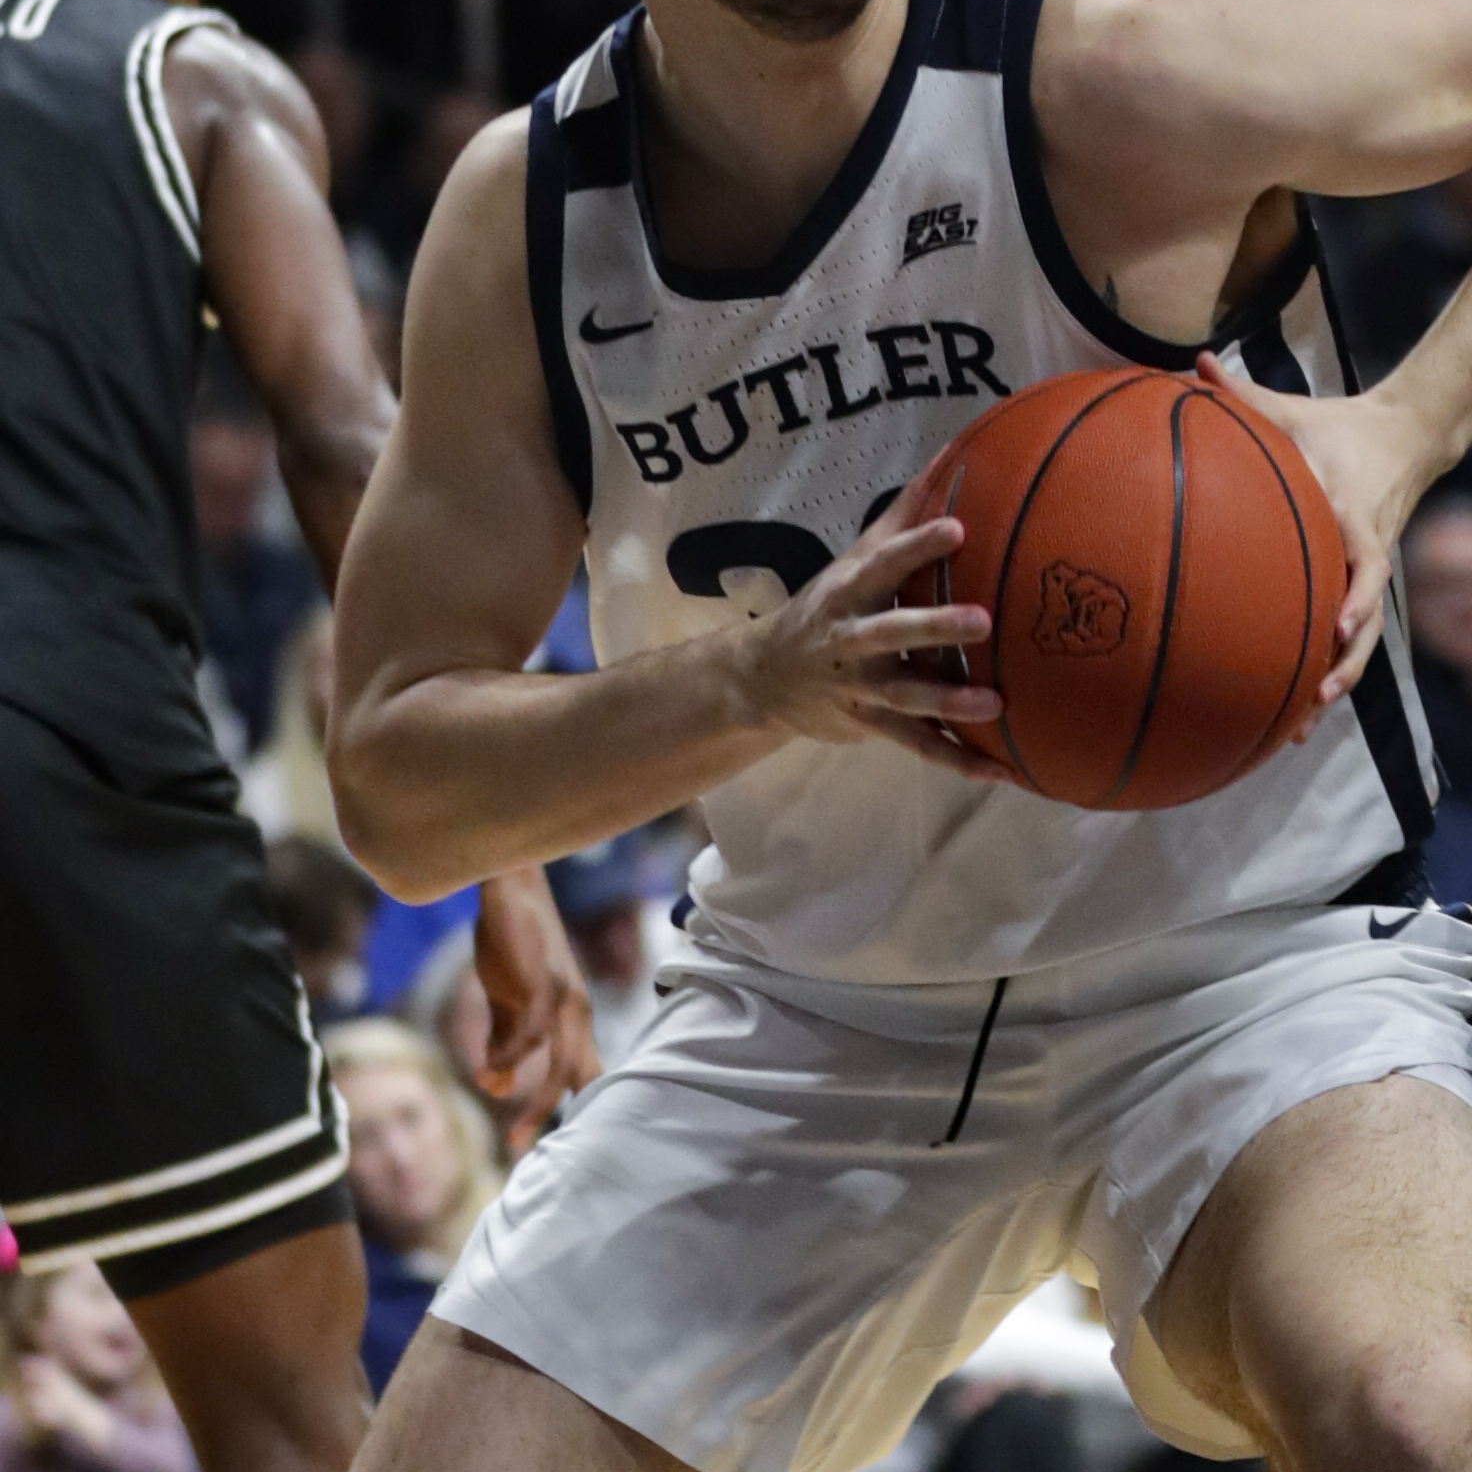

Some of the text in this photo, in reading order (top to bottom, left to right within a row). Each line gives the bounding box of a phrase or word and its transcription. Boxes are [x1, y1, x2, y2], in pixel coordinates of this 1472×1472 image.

[908, 202, 963, 228] BIG
[903, 218, 979, 254] EAST
[616, 321, 1012, 483] BUTLER
